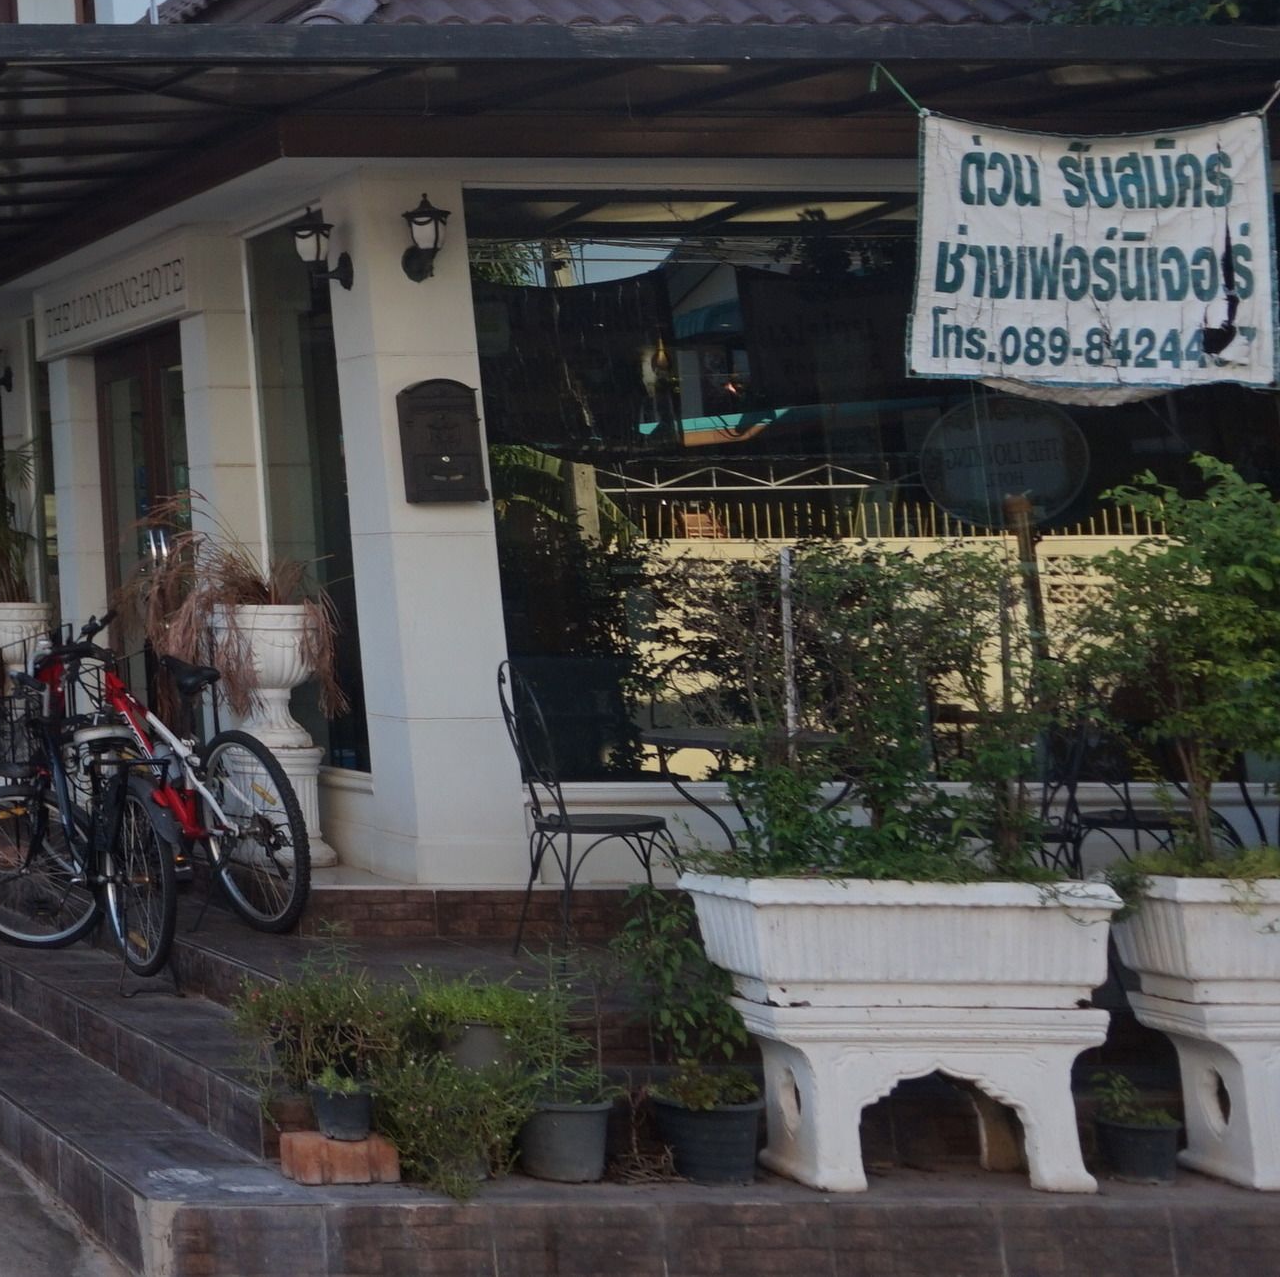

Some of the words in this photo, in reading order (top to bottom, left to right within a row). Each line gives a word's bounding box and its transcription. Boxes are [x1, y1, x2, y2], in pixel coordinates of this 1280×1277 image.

[959, 134, 1042, 207] ด่วน
[1057, 137, 1235, 209] รับสมัคร
[45, 302, 71, 338] THE
[71, 289, 102, 329] LION
[103, 276, 140, 318] KING
[140, 256, 185, 305] HOTE
[931, 305, 1257, 369] โทร.089-84244
